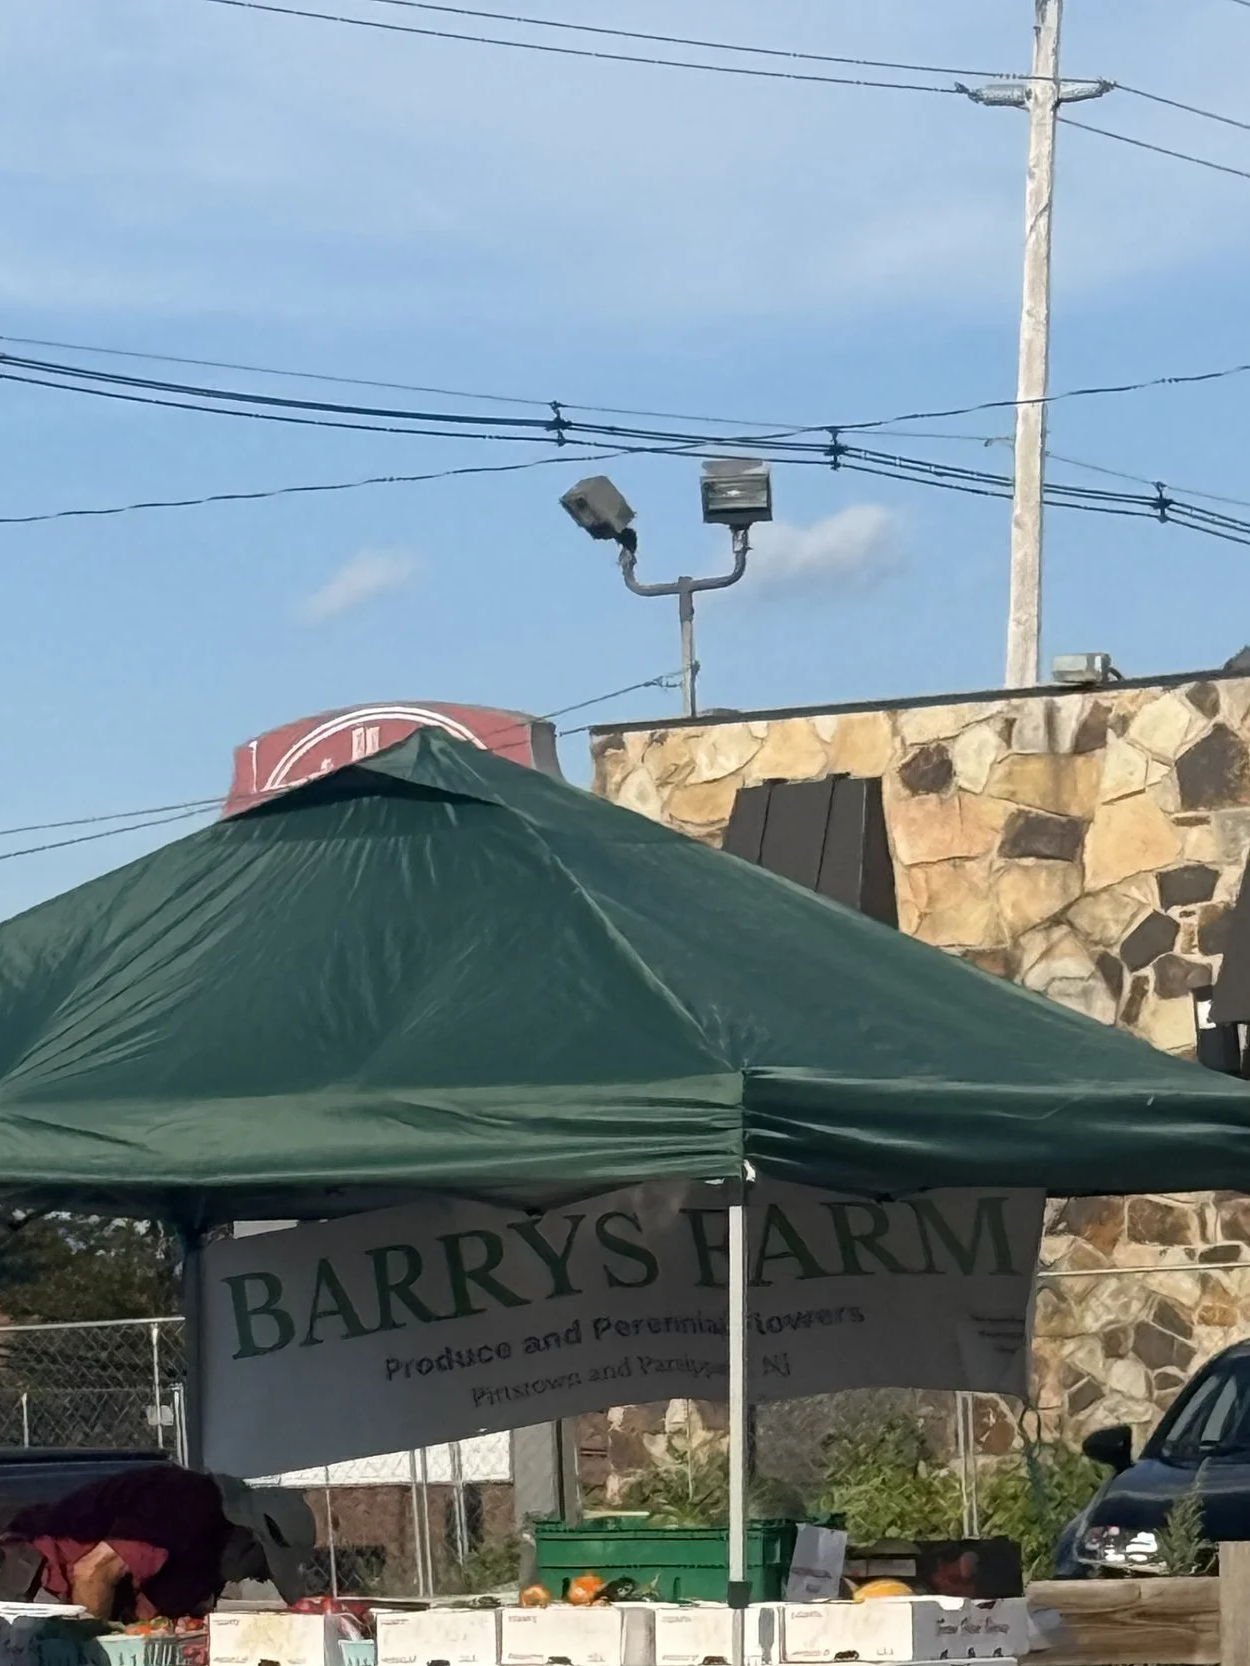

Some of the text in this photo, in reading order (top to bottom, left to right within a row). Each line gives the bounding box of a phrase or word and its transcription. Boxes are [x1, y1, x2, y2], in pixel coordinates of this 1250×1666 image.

[220, 1197, 1023, 1361] BARRYS FARM
[385, 1342, 513, 1382] Produce
[522, 1319, 583, 1355] and
[746, 1305, 866, 1336] lowers
